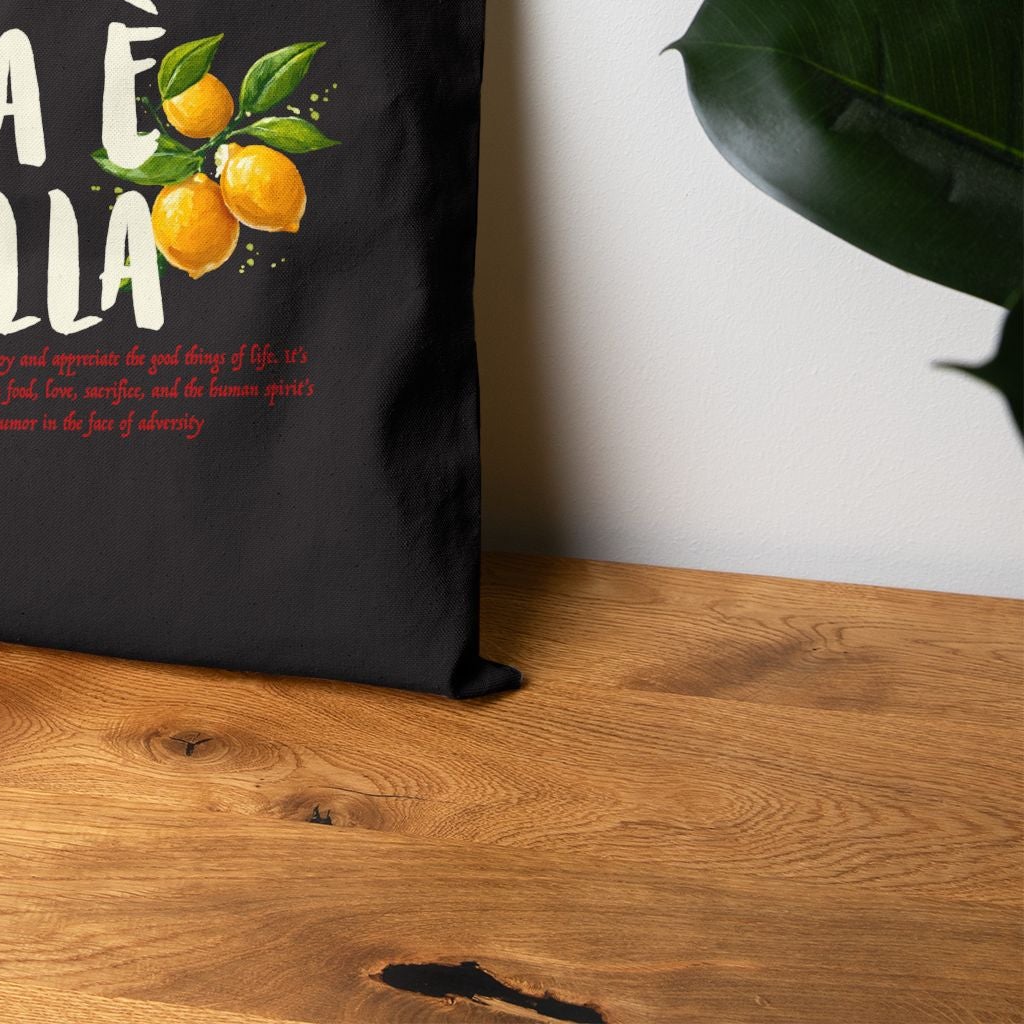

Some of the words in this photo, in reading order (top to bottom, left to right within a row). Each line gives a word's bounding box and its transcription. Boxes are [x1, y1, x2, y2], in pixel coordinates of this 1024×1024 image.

[20, 345, 49, 368] and
[52, 349, 121, 378] appreciate
[125, 344, 145, 367] the
[148, 343, 182, 377] good
[185, 343, 226, 376] things
[231, 342, 247, 373] of
[1, 377, 39, 406] food,
[45, 377, 78, 401] love,
[83, 376, 145, 407] sacrifice,
[151, 375, 182, 399] and
[183, 375, 205, 399] the
[208, 375, 259, 398] human
[42, 413, 57, 431] in
[63, 409, 83, 432] the
[82, 409, 115, 439] face
[120, 409, 136, 439] of
[138, 408, 206, 441] adversity
